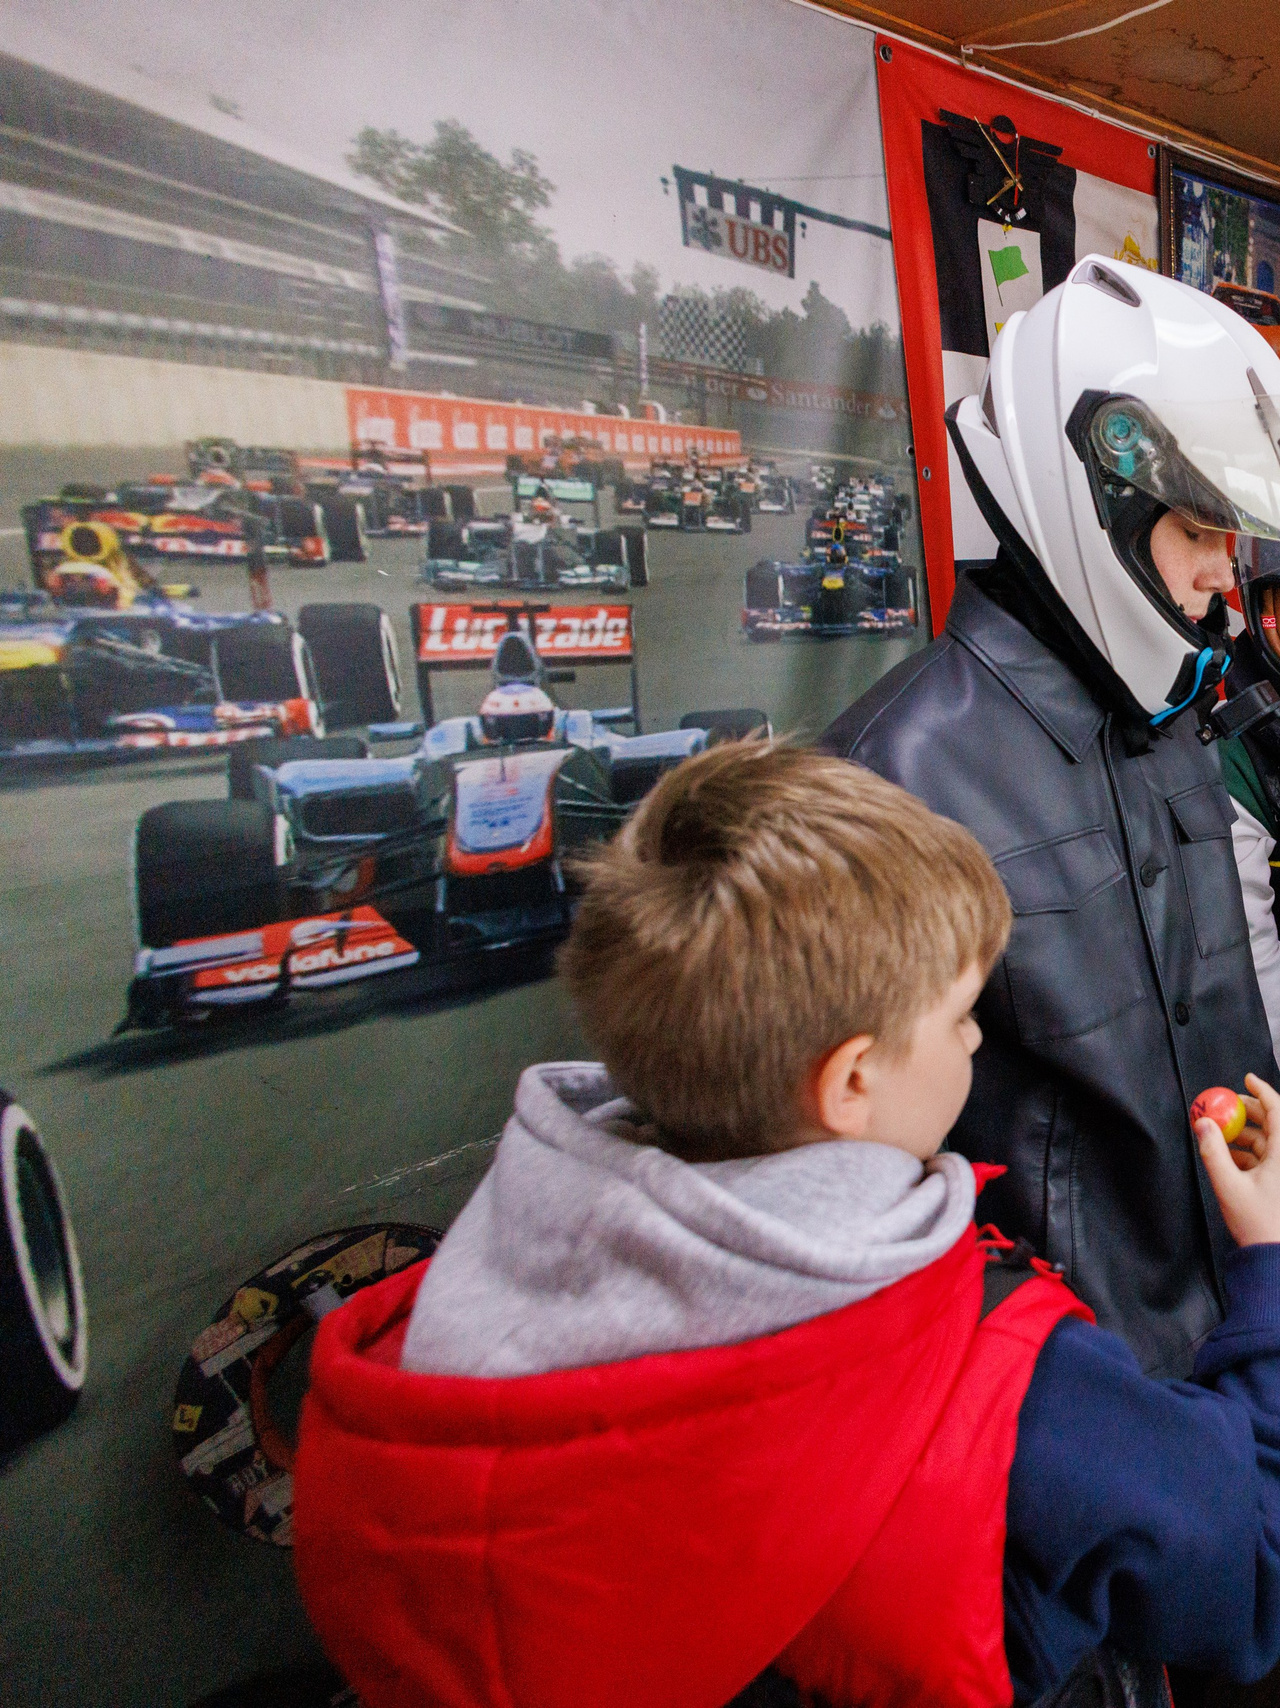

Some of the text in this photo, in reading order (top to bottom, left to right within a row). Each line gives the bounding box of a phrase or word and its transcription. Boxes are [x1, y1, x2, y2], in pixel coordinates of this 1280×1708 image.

[724, 218, 789, 271] UBS
[768, 382, 871, 416] Santander
[424, 605, 629, 652] Luczade
